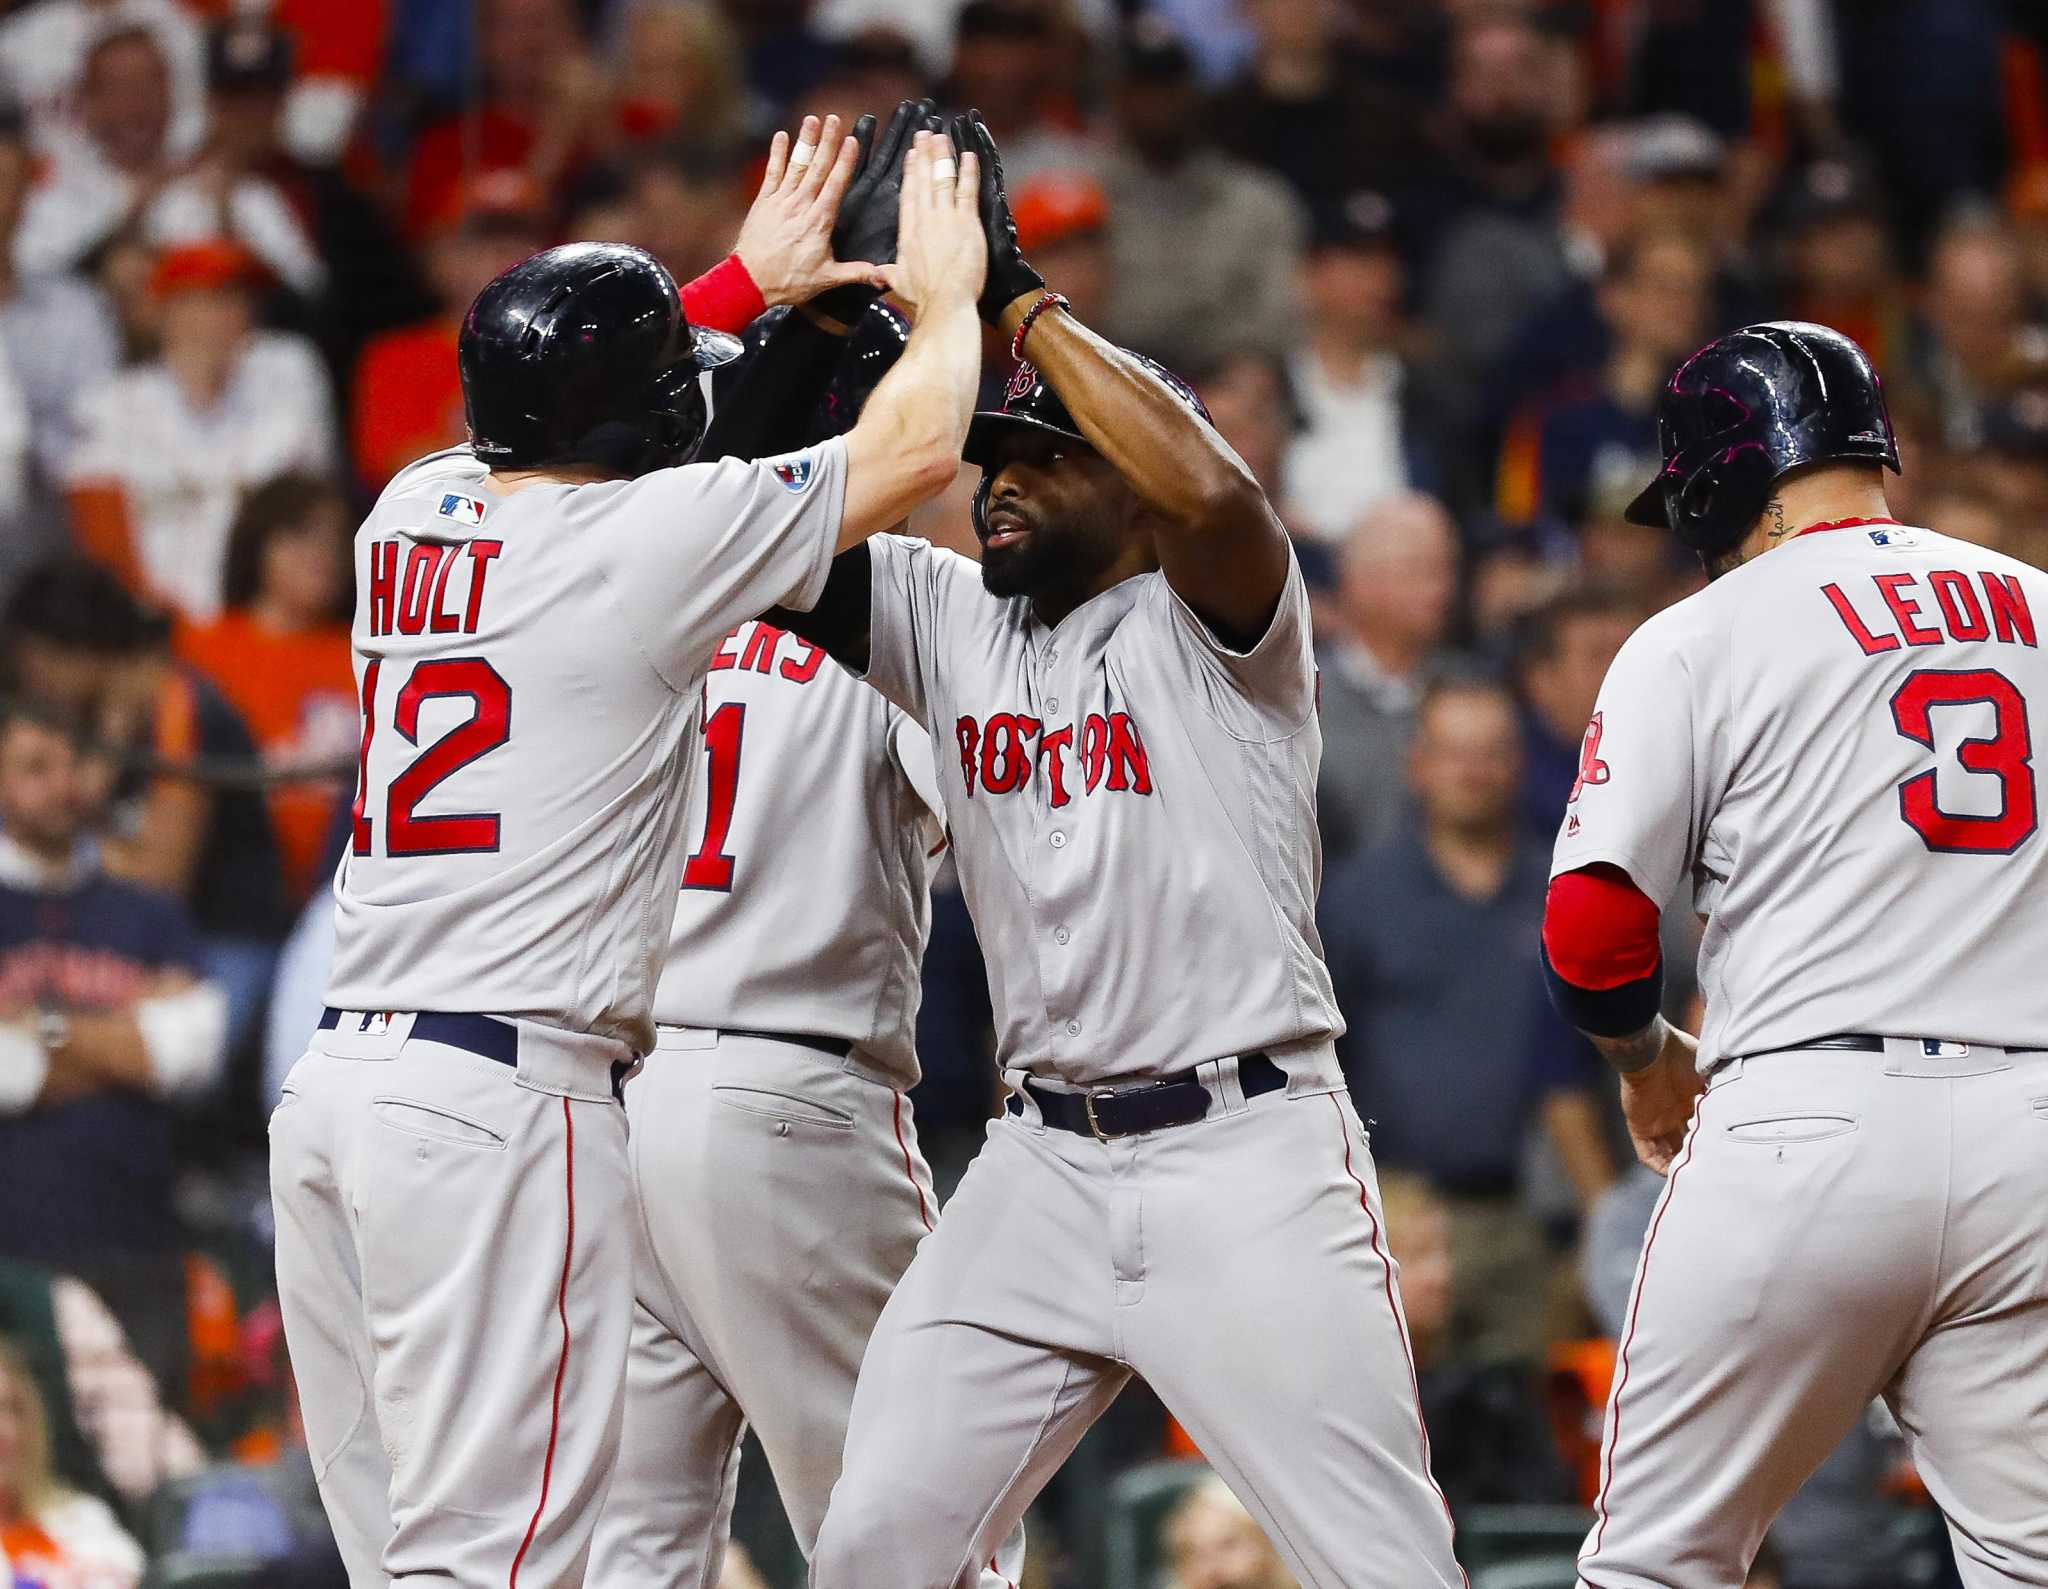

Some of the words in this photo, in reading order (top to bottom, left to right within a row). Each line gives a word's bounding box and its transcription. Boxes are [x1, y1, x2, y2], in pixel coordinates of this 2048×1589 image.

[370, 539, 503, 637] HOLT
[1819, 570, 2038, 656] LEON
[352, 656, 513, 858] 12
[680, 702, 747, 893] 1
[955, 711, 1153, 809] BOSTON
[1889, 668, 2038, 855] 3
